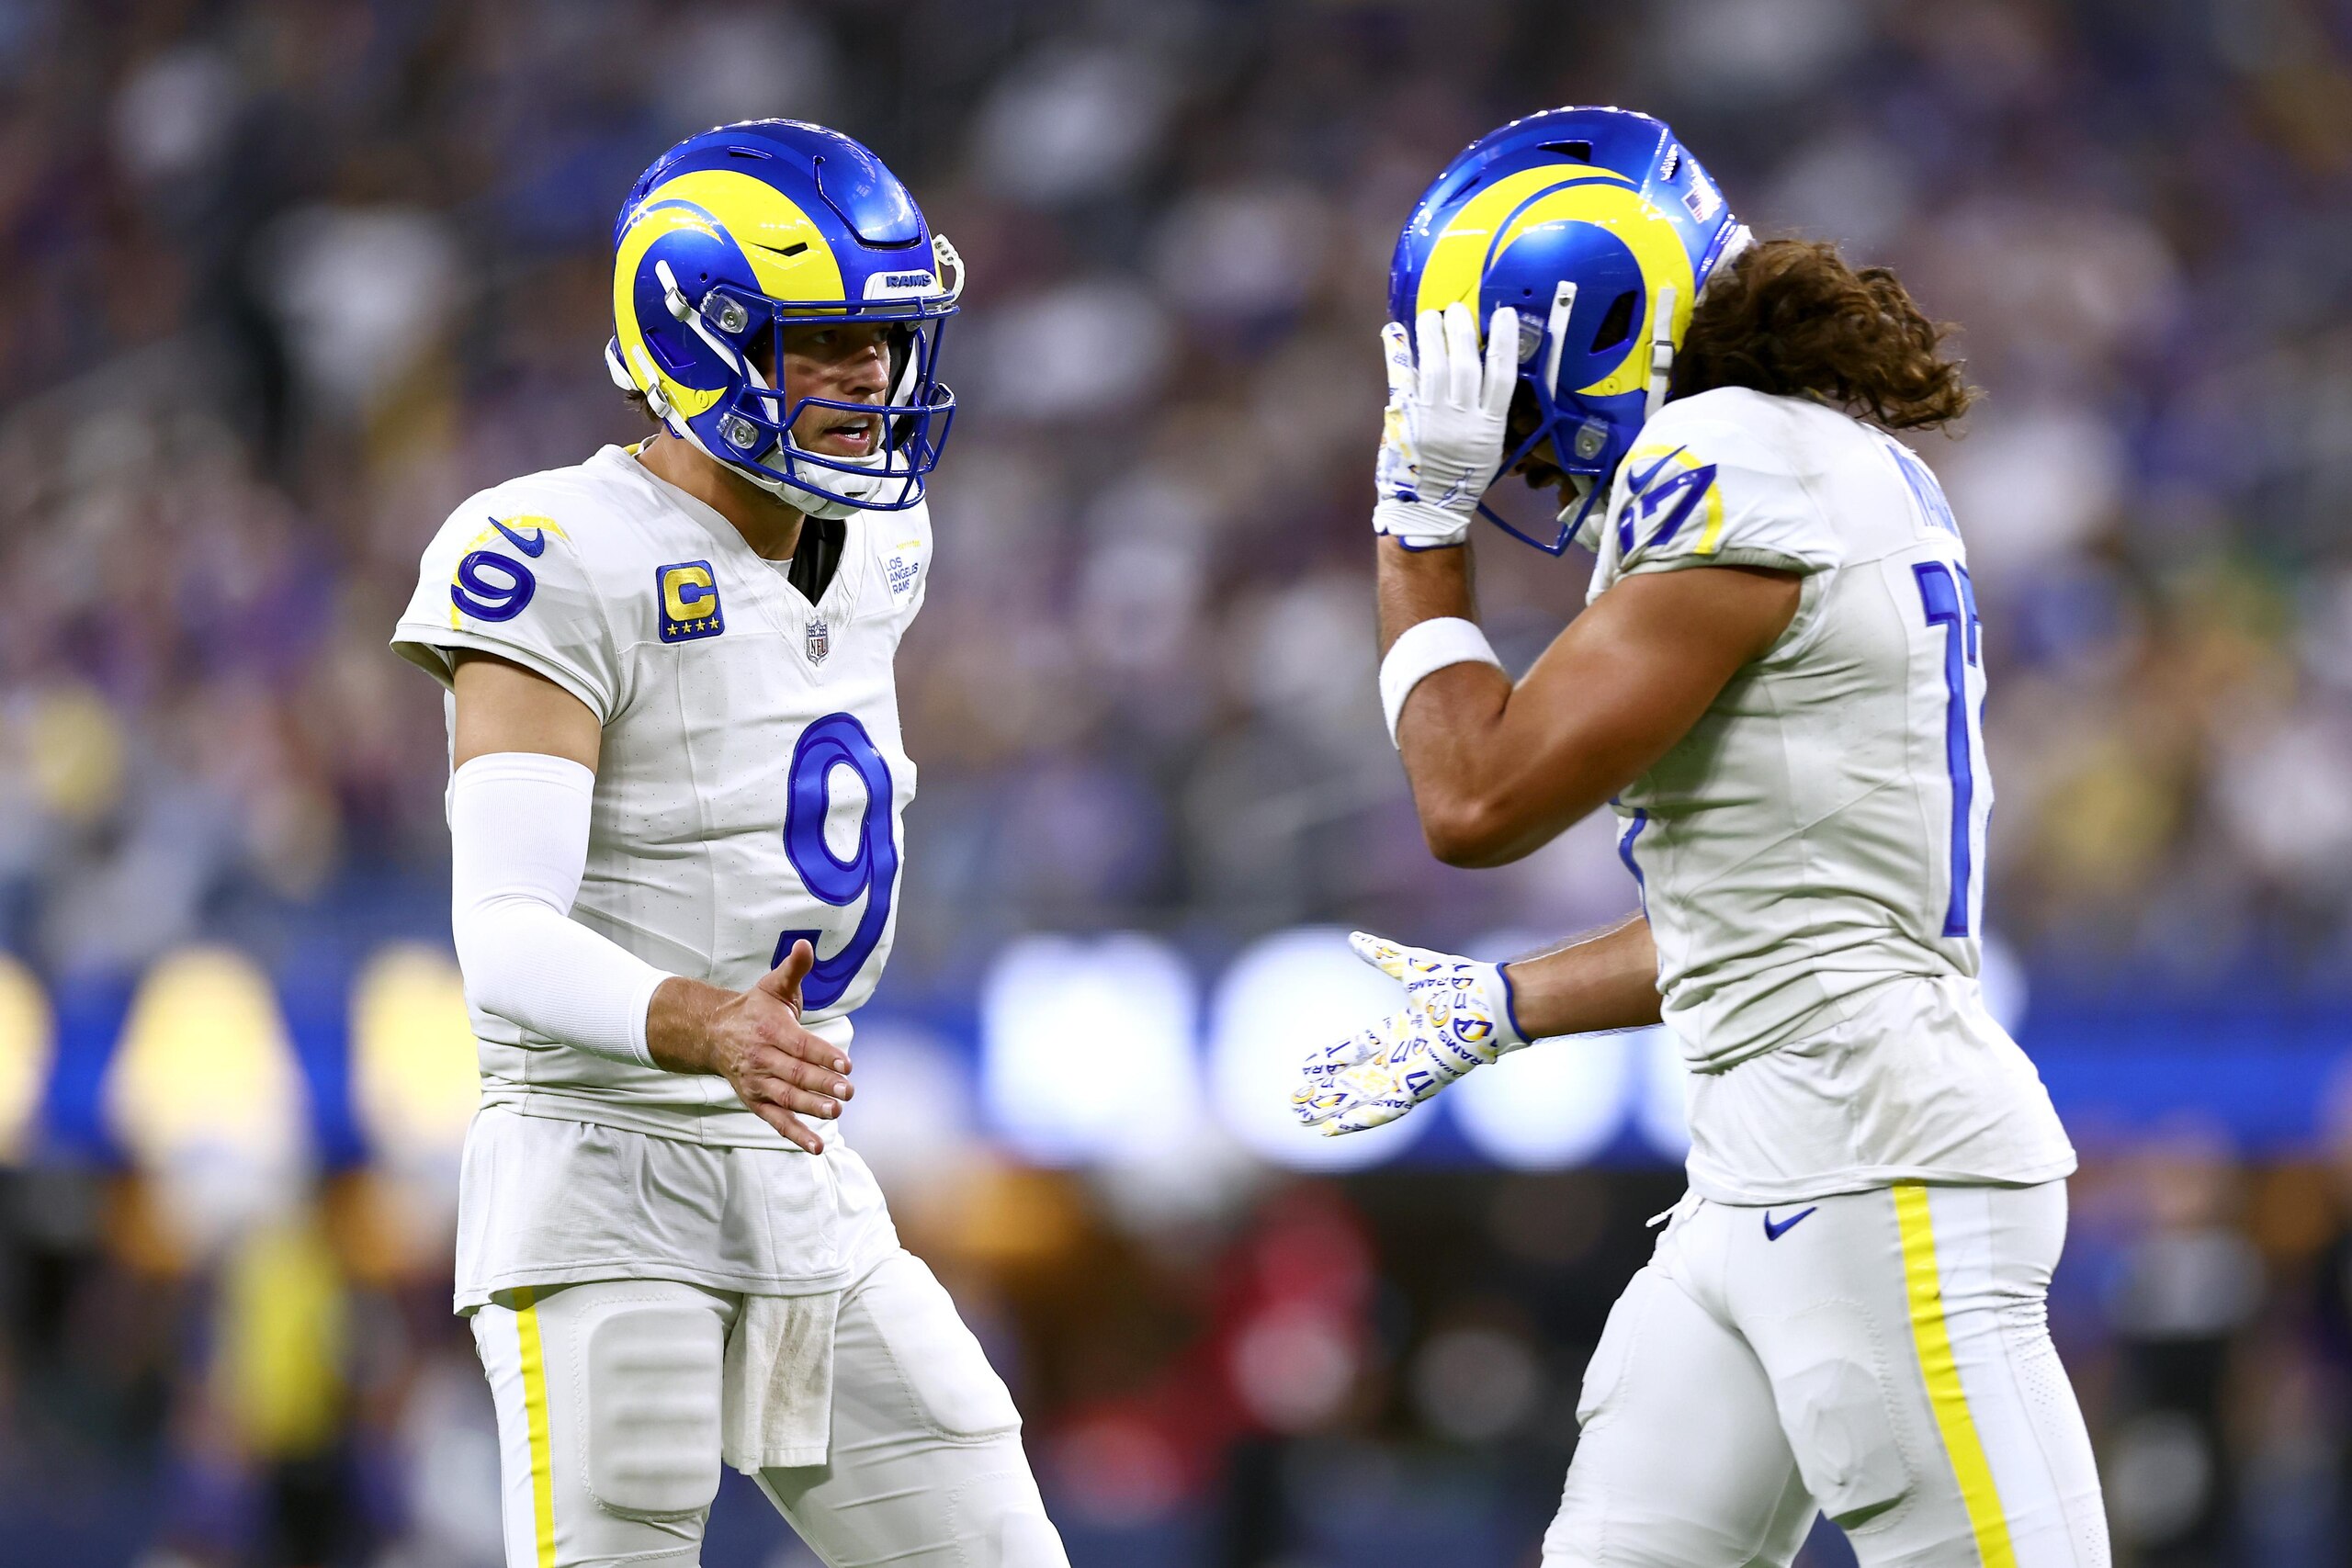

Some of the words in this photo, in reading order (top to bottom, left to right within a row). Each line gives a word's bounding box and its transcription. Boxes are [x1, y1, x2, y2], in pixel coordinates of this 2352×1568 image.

[886, 275, 932, 288] RAMS
[885, 557, 903, 571] LOS
[451, 550, 536, 623] 9
[663, 566, 717, 622] C
[810, 638, 826, 657] NFL
[771, 712, 898, 1011] 9
[1453, 1015, 1493, 1043] LA
[1438, 1030, 1484, 1066] RAMS
[1406, 1070, 1435, 1096] 17
